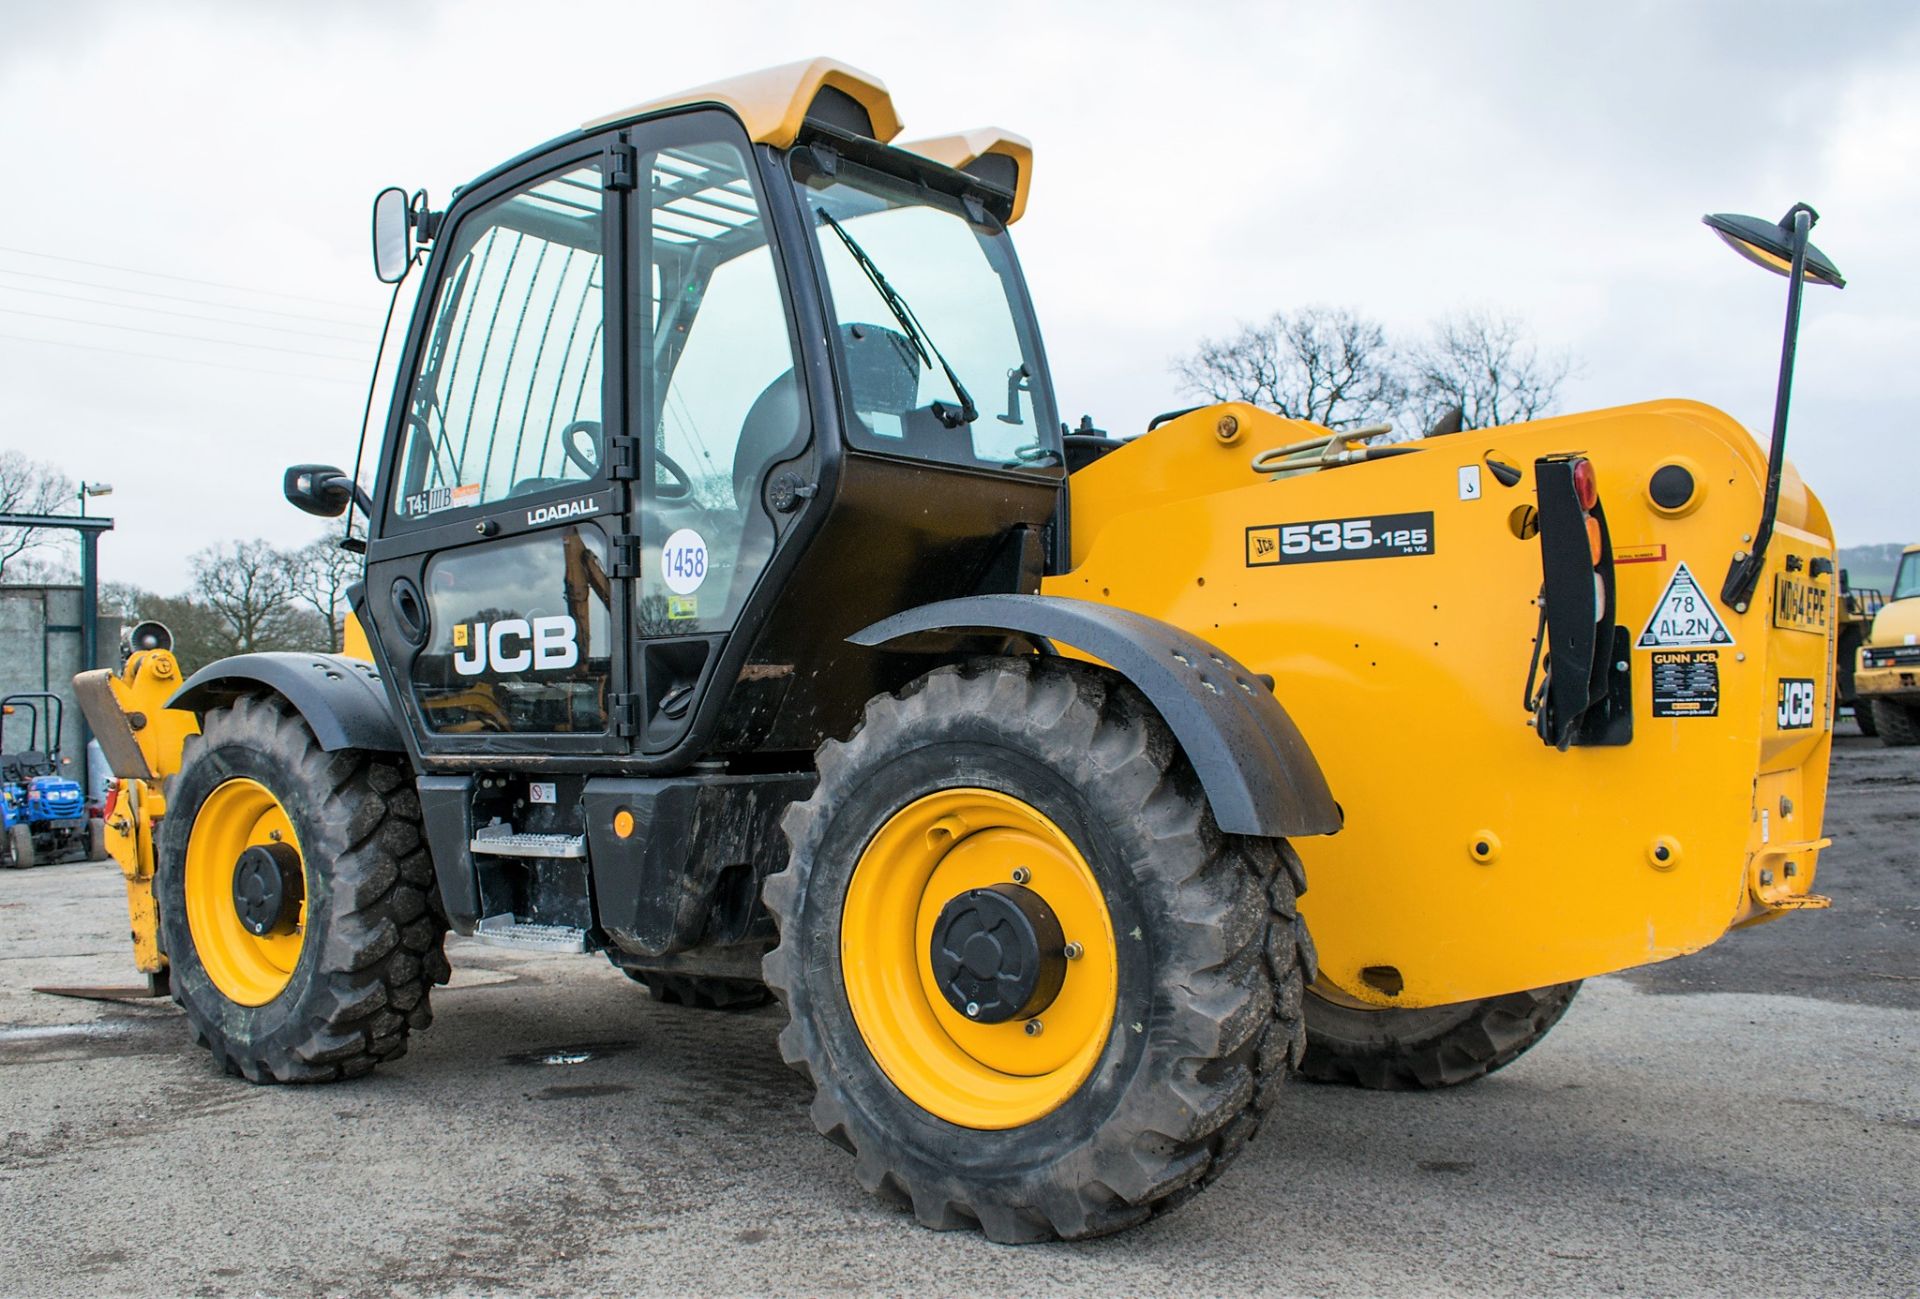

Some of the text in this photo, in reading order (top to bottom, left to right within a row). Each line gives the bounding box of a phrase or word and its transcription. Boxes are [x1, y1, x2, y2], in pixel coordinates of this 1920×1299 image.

[406, 494, 428, 516] T4i
[527, 498, 599, 525] LOADALL
[1254, 537, 1275, 554] JCB
[665, 547, 704, 578] 1458
[1671, 596, 1695, 613] 78
[1807, 587, 1826, 626] EPE
[1660, 618, 1709, 637] AL2N
[453, 615, 579, 676] JCB
[1654, 653, 1717, 664] GUNN JCB
[1778, 682, 1814, 726] JCB
